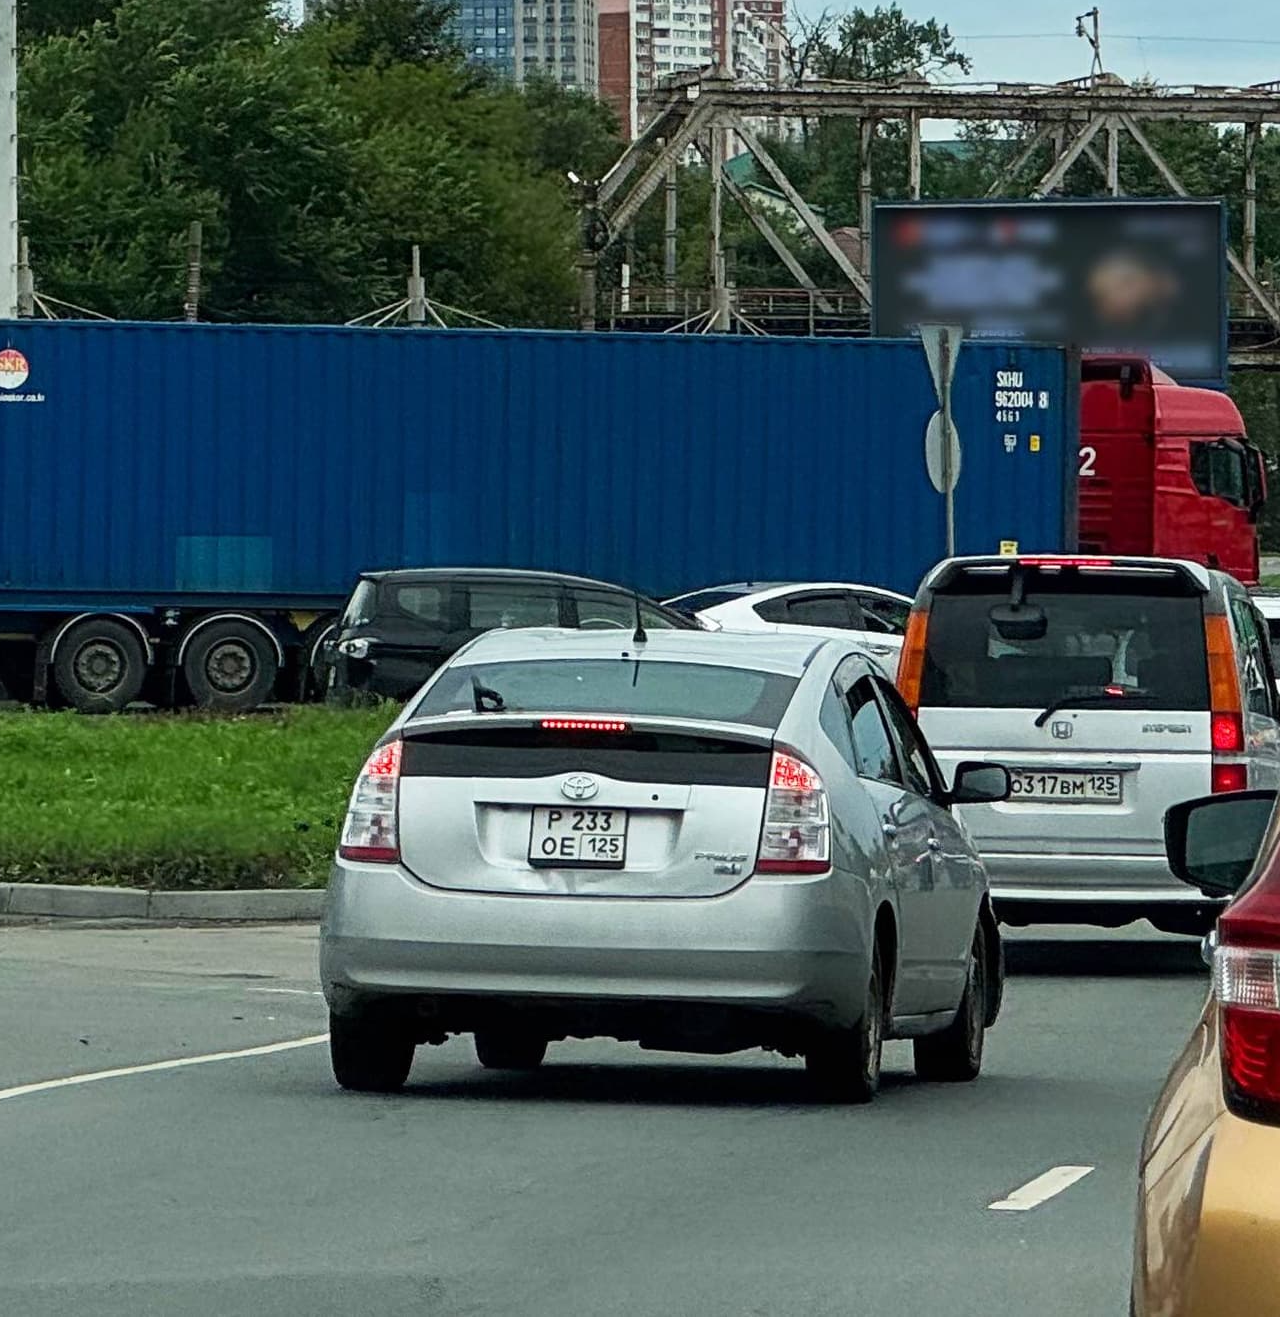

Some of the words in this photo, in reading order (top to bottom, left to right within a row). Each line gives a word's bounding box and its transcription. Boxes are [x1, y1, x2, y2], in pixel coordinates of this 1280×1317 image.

[995, 391, 1034, 408] 962004
[1039, 392, 1049, 409] 8
[1078, 446, 1097, 476] 2
[1088, 776, 1115, 792] 125
[572, 811, 612, 831] 233
[587, 838, 619, 853] 125
